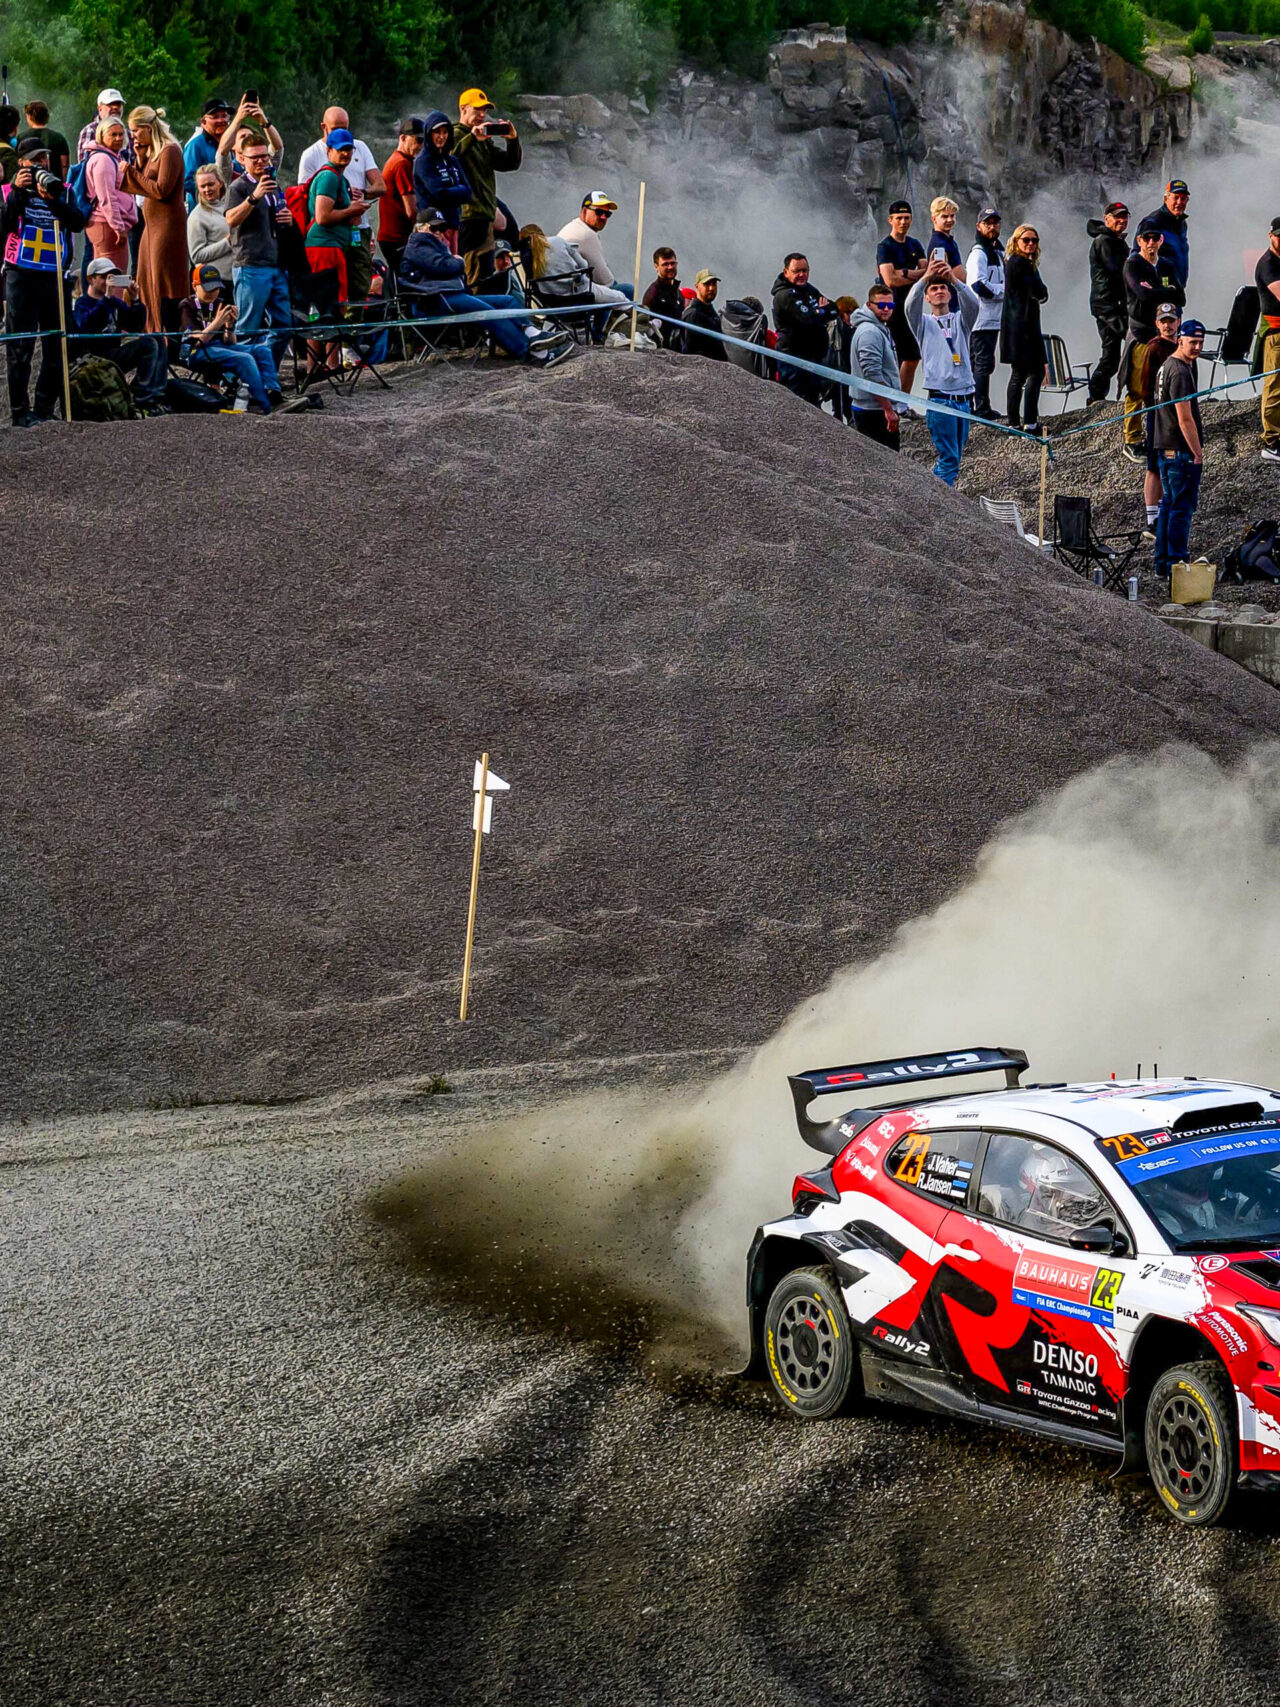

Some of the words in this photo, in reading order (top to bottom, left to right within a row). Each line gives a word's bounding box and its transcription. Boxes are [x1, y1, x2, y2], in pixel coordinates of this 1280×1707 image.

[826, 1053, 986, 1084] Rally2
[1143, 1133, 1171, 1147] GR
[1172, 1124, 1228, 1139] TOYOTA
[1229, 1120, 1276, 1129] GAZOO
[893, 1133, 932, 1184] 23
[1102, 1133, 1149, 1160] 23
[1201, 1143, 1233, 1155] FOLLOW
[1234, 1141, 1244, 1149] US
[1020, 1261, 1092, 1290] BAUHAUS
[1092, 1268, 1122, 1309] 23
[1036, 1297, 1045, 1306] FIA
[1057, 1302, 1091, 1318] Championship
[1117, 1306, 1139, 1320] PIAA
[872, 1326, 930, 1356] Rally2
[1200, 1315, 1239, 1357] AUTOMOTIVE
[1208, 1311, 1248, 1352] Panasonic
[1033, 1340, 1098, 1378] DENSO
[1041, 1370, 1096, 1396] TAMADIC
[1032, 1388, 1063, 1402] TOYOTA
[1063, 1397, 1091, 1410] GAZOO
[1091, 1404, 1116, 1420] Racing
